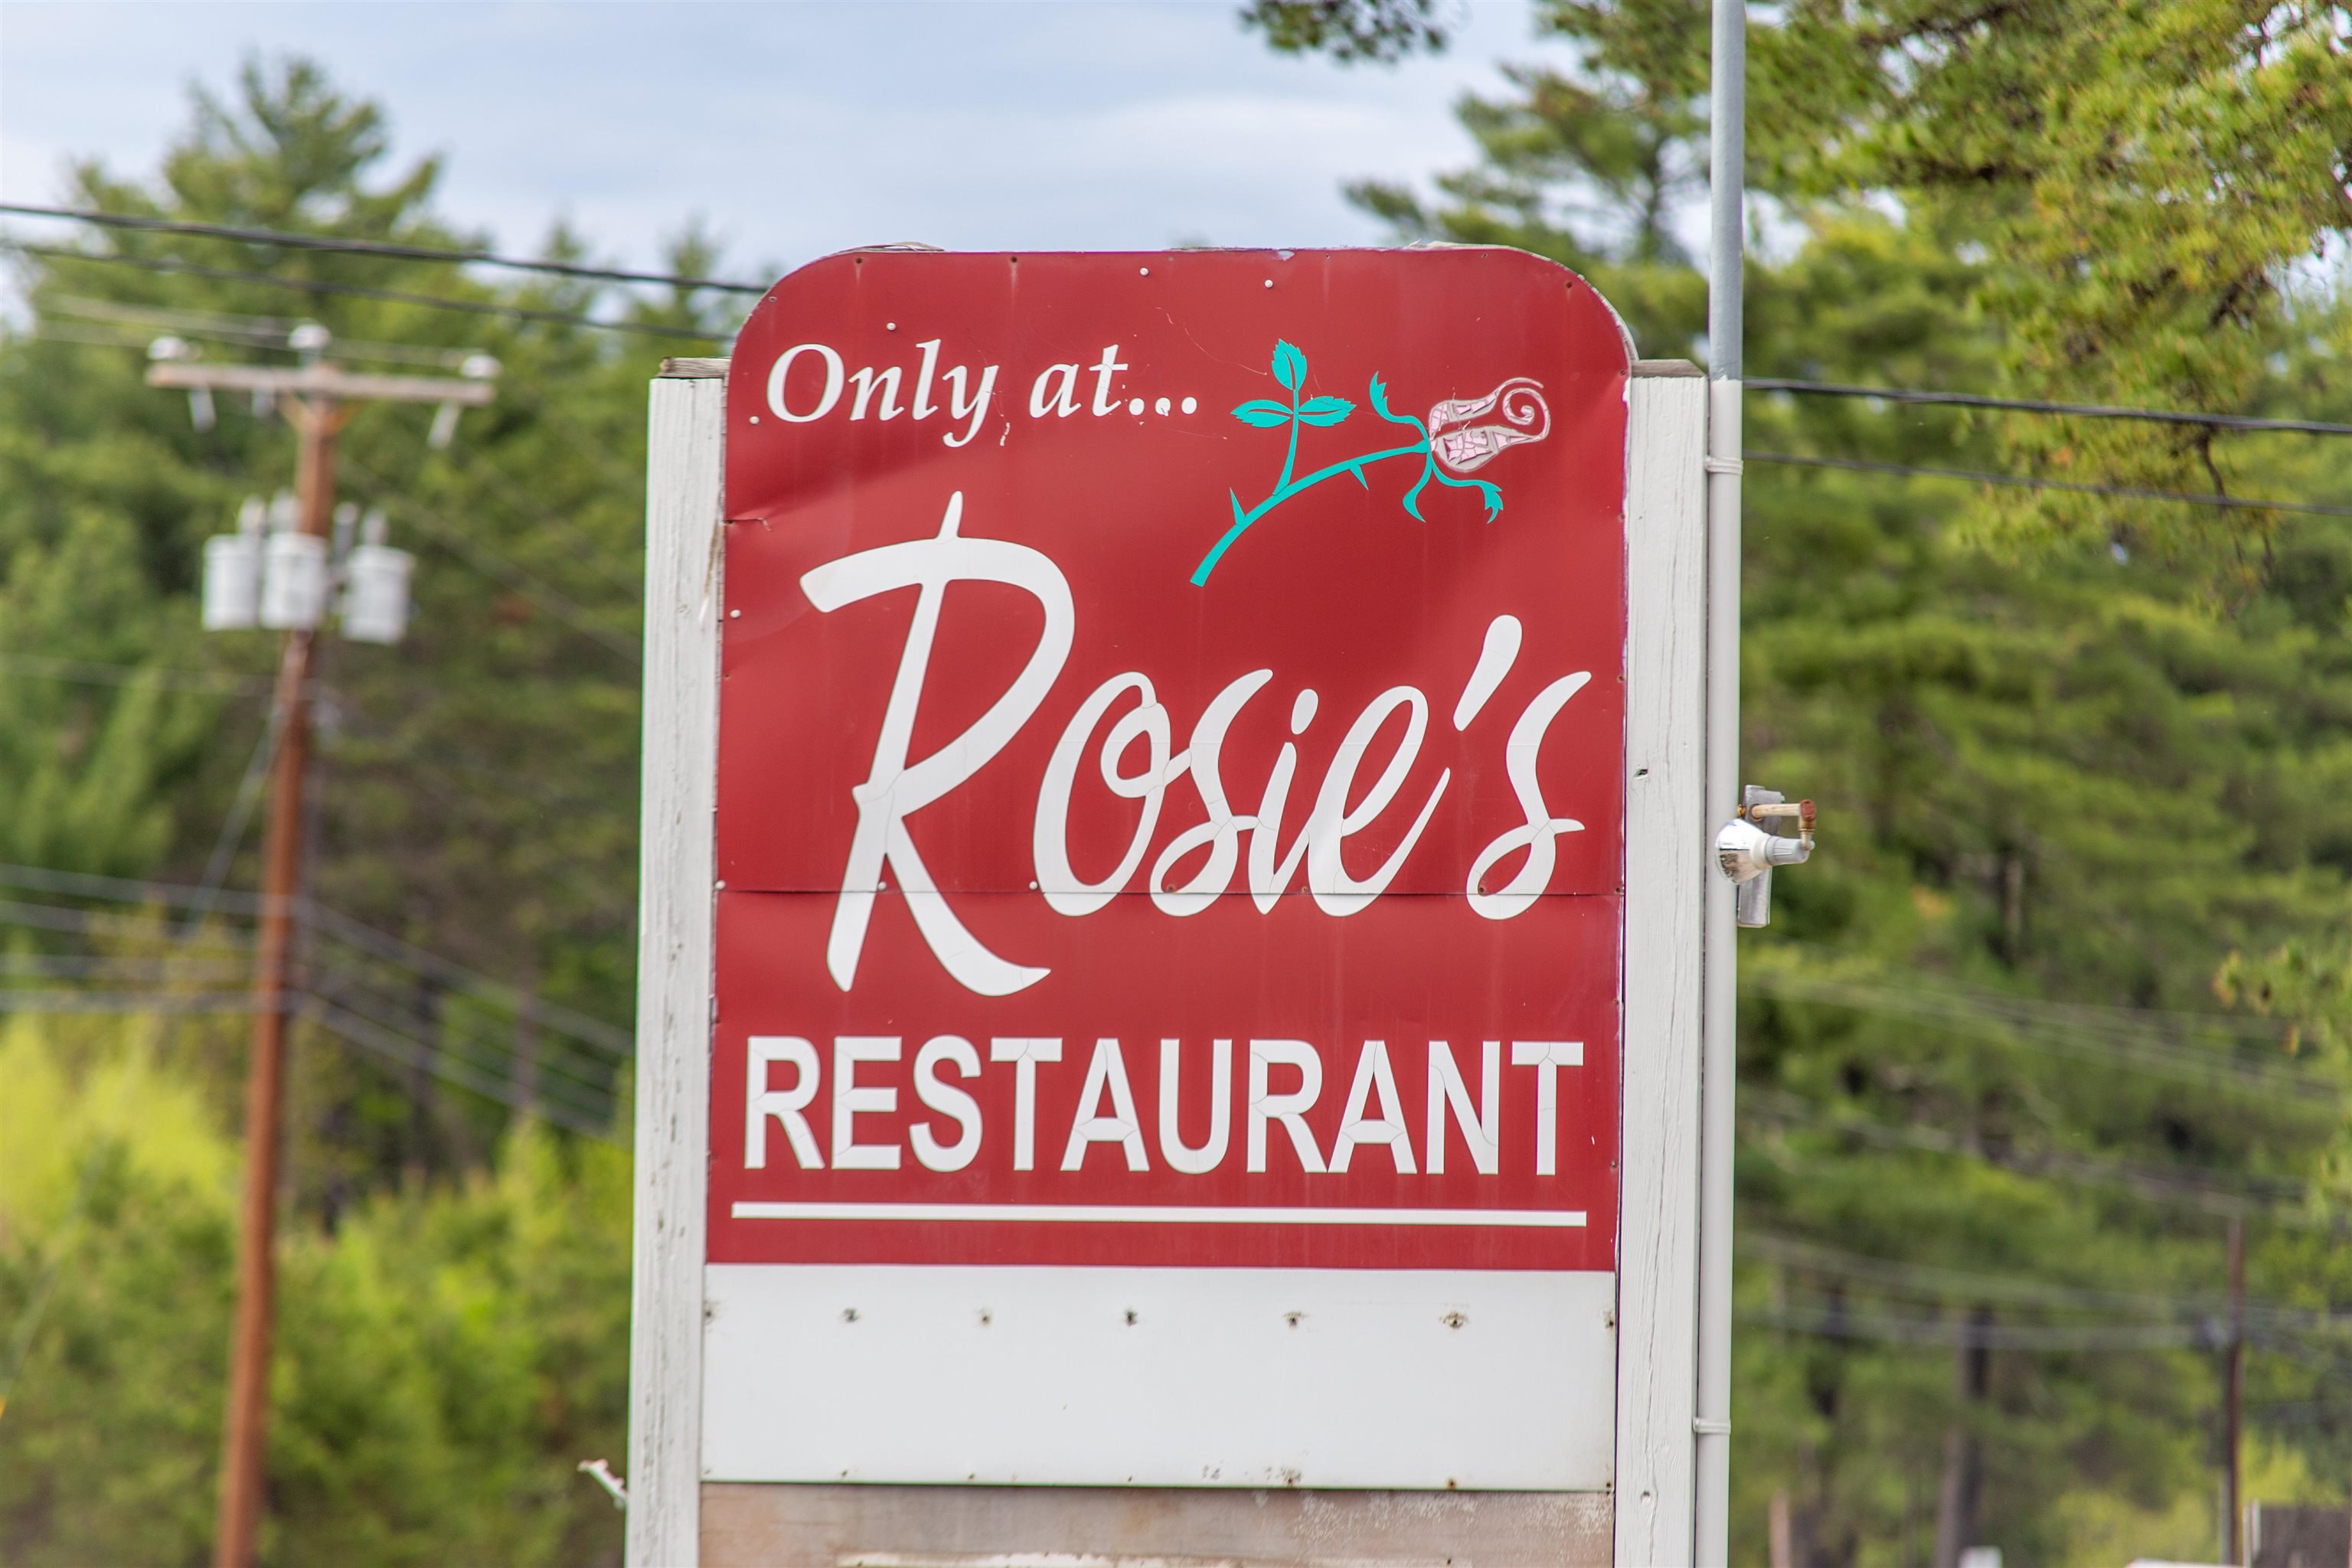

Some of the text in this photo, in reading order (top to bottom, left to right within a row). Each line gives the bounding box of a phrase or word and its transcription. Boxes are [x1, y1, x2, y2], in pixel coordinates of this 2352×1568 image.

[766, 338, 1198, 448] Only at...
[800, 491, 1592, 997] Rosie's
[744, 1035, 1584, 1176] RESTAURANT
